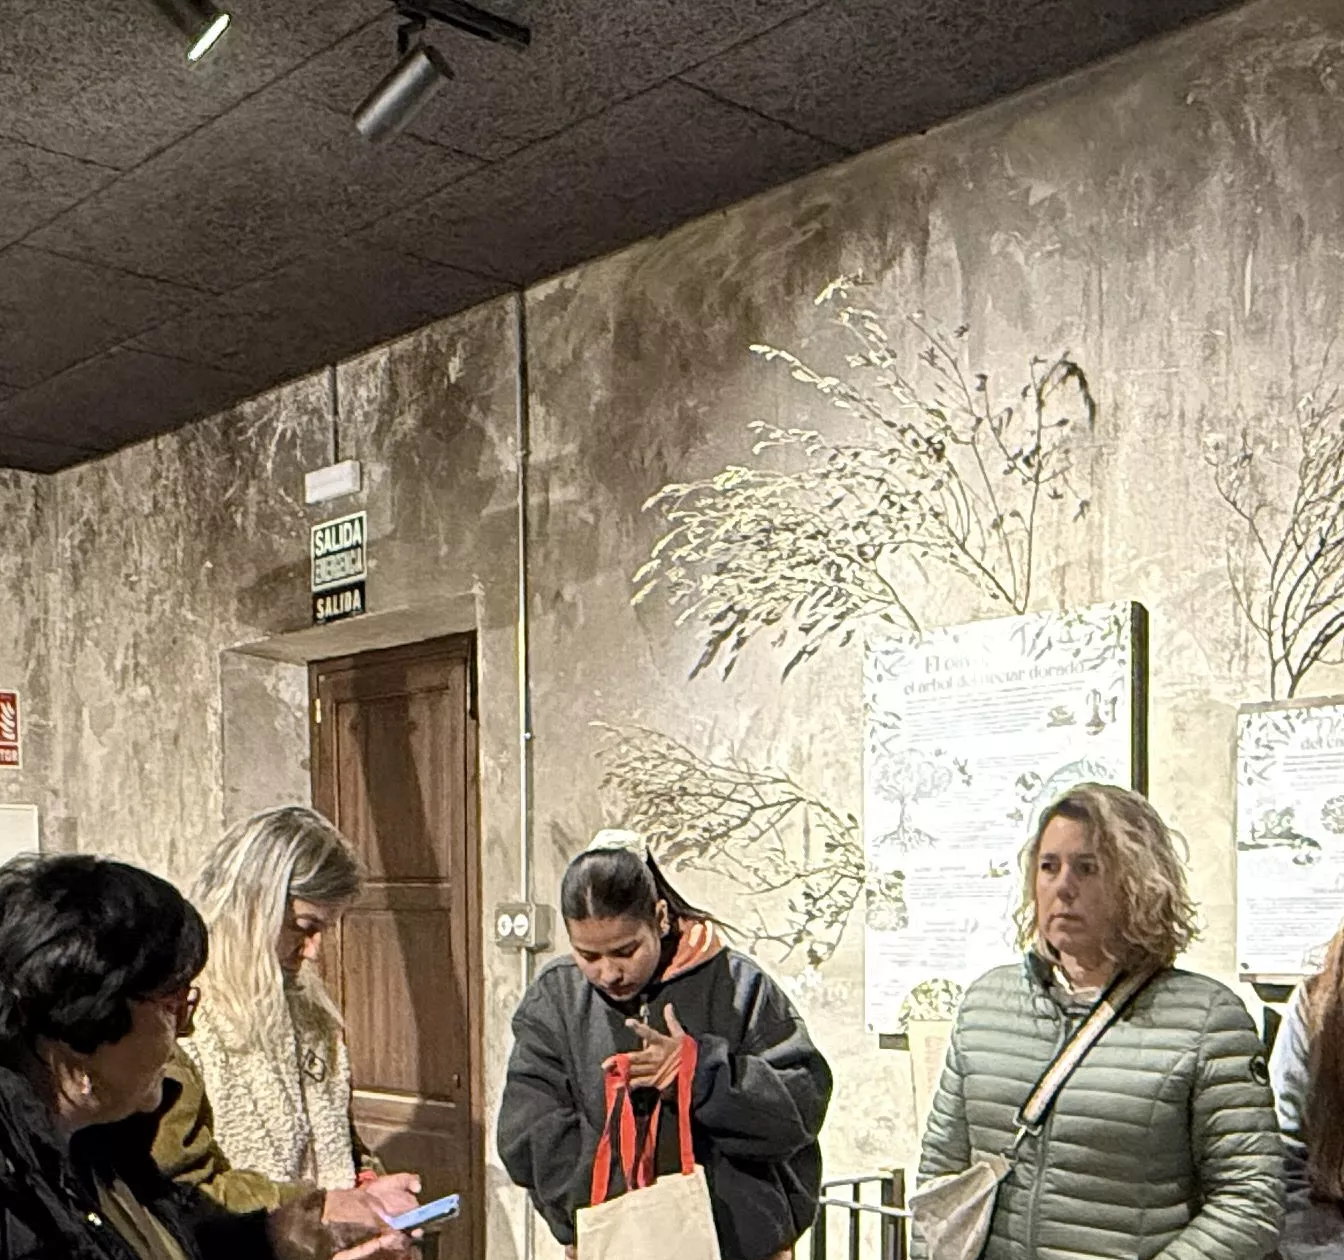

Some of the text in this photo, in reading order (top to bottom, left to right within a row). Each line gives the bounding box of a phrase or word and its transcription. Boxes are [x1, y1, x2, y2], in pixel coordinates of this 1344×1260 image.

[314, 519, 362, 557] SALIDA
[316, 589, 362, 619] SALIDA
[1029, 660, 1085, 679] dorado
[1300, 735, 1324, 750] del
